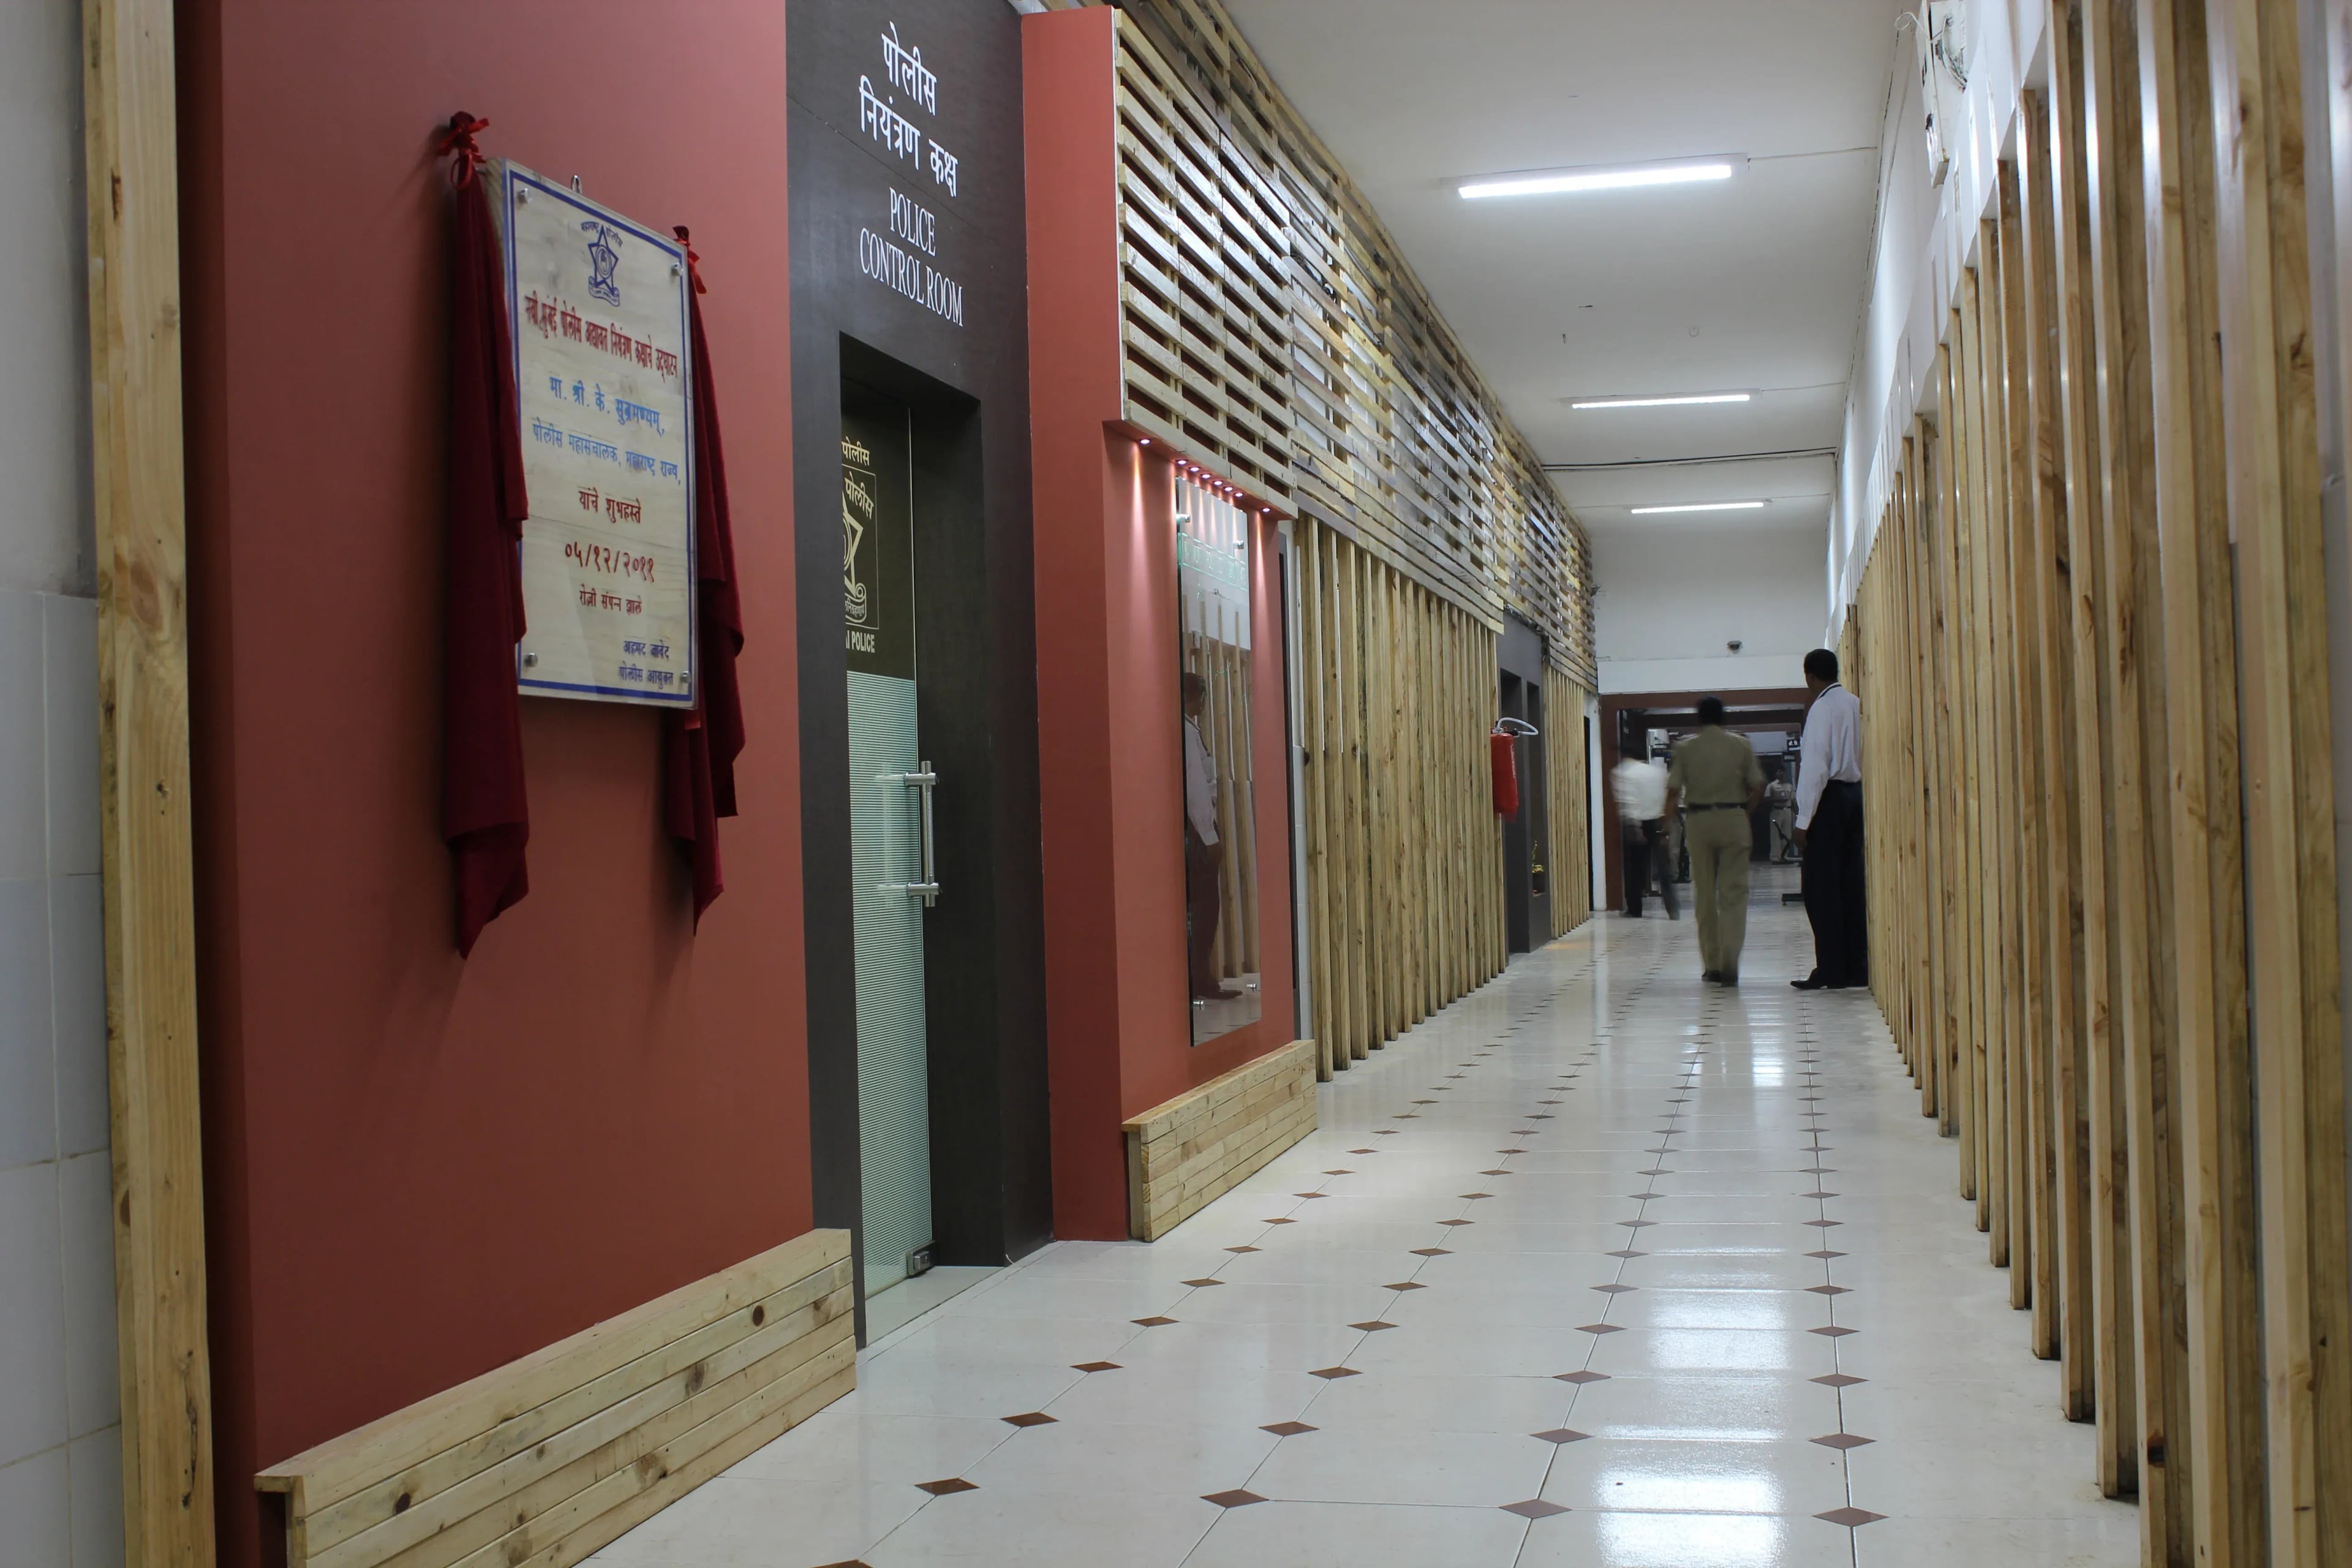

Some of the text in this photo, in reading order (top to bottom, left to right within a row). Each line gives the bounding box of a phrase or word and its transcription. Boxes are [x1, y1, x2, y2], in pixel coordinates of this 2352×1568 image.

[882, 21, 937, 115] पोलीस
[859, 75, 958, 197] नियंत्रण कक्ष
[889, 187, 936, 256] POLICE
[860, 228, 963, 326] CONTROL ROOM
[560, 300, 581, 343] पोलीस
[611, 322, 631, 362] नियंत्रण
[549, 377, 567, 400] मा.
[595, 383, 610, 413] के.
[532, 417, 562, 448] पोलीस
[842, 436, 870, 466] पोलीस
[606, 497, 641, 523] शुभहस्ते
[845, 471, 874, 519] पोलीस
[851, 631, 875, 653] POLICE
[619, 660, 643, 682] पोलीस
